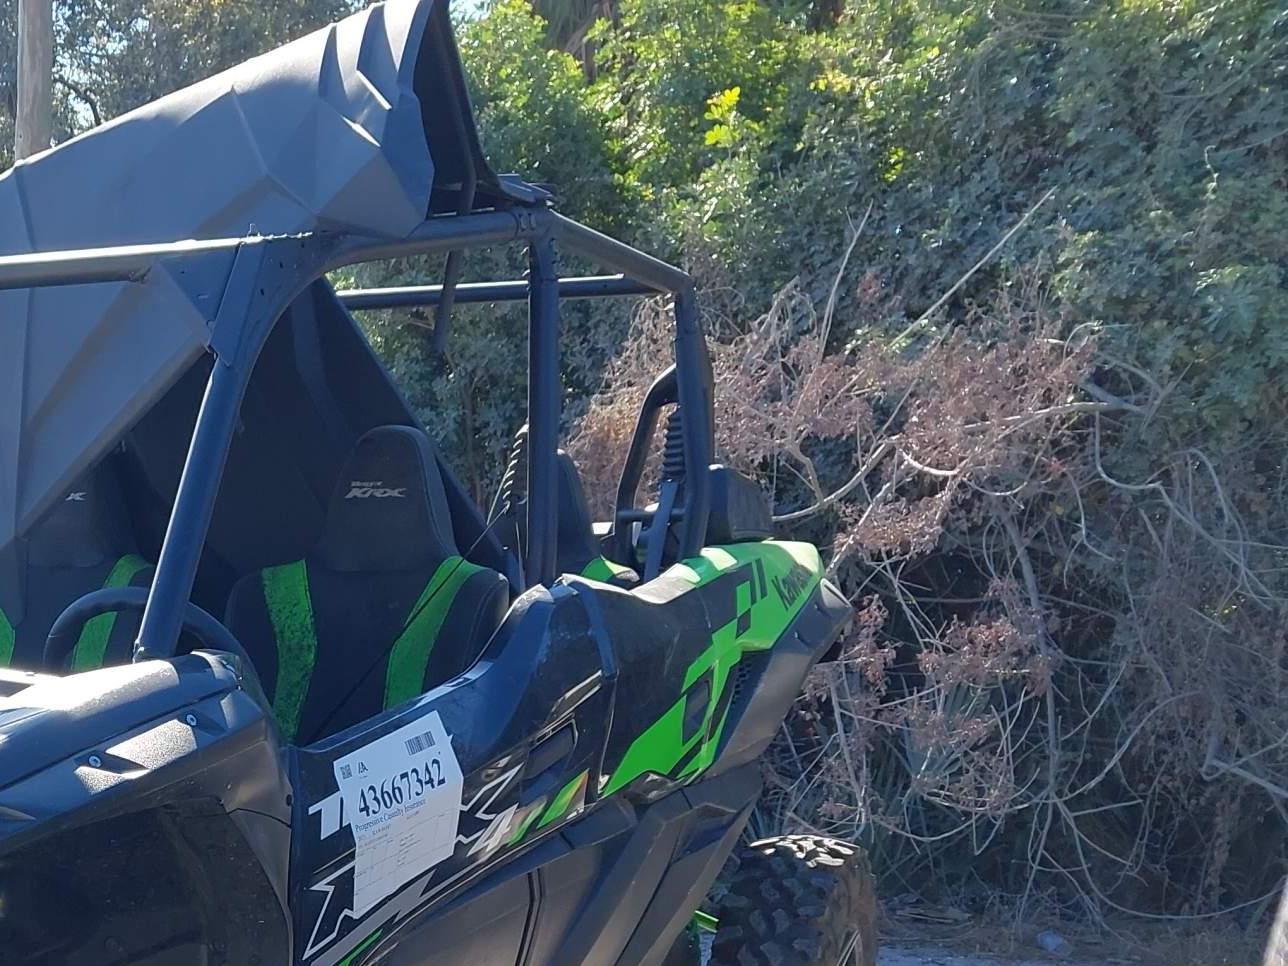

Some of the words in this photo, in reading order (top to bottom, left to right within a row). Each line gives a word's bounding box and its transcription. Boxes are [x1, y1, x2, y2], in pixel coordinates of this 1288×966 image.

[344, 487, 408, 499] KRX
[358, 758, 446, 818] 43667342
[355, 816, 384, 833] Progressive
[383, 807, 404, 821] Casualty
[404, 798, 426, 814] Insurance
